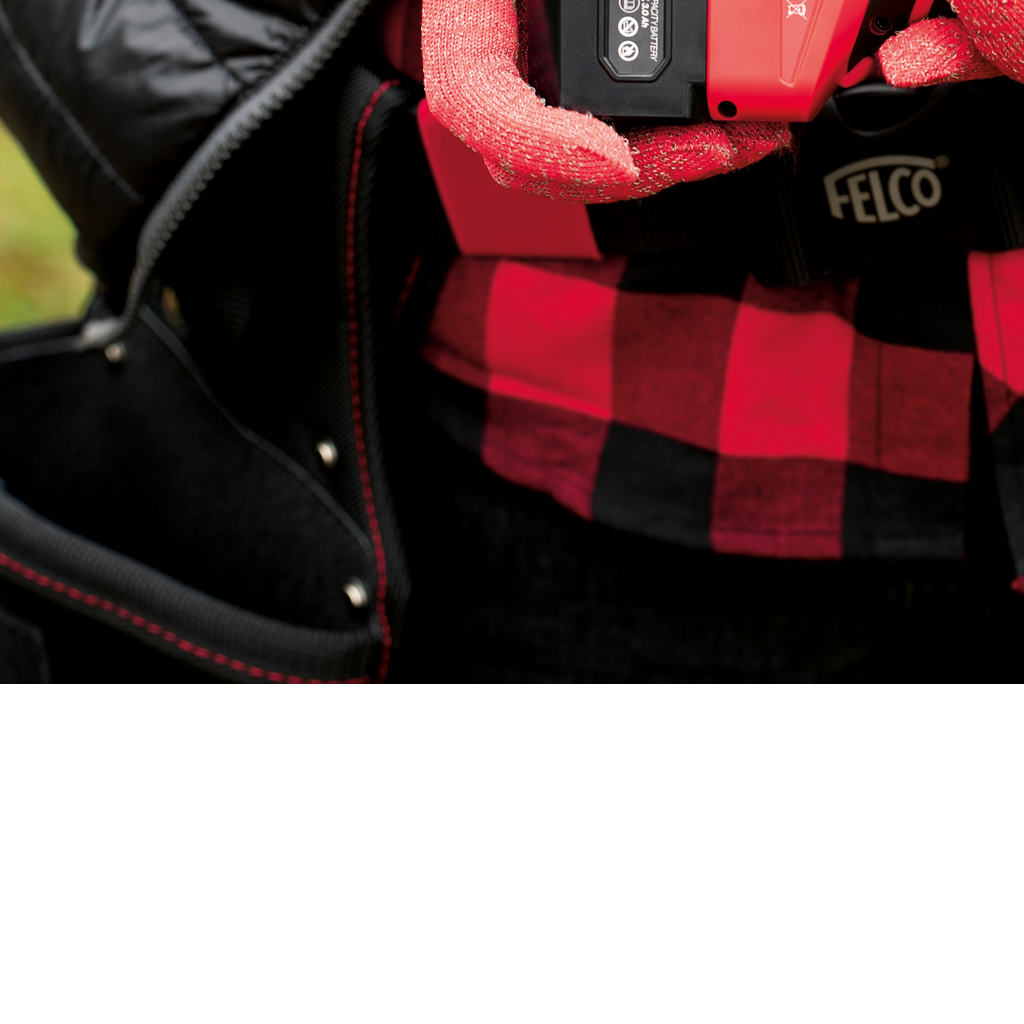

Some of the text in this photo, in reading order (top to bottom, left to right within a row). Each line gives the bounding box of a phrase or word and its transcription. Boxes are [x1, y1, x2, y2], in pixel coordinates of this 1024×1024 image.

[641, 16, 650, 29] Ah
[649, 26, 659, 62] BATTERY
[823, 154, 943, 224] FELCO
